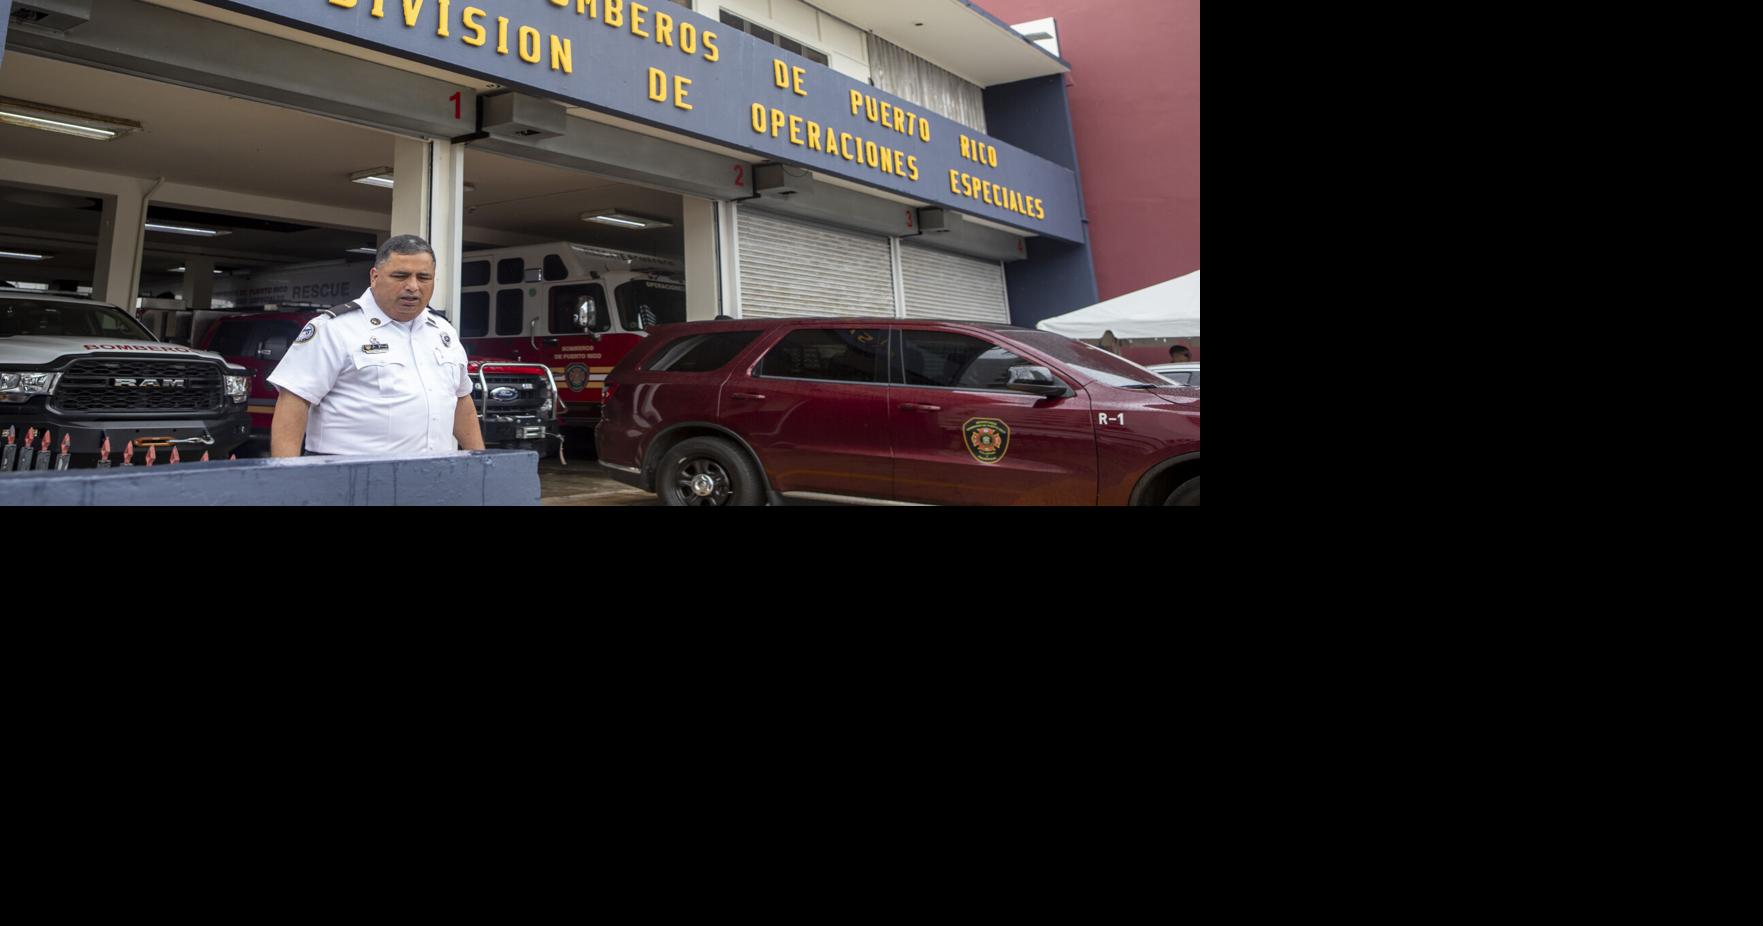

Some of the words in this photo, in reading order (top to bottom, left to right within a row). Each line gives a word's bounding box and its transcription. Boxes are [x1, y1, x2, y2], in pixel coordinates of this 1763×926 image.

[548, 0, 720, 62] BEROS
[773, 59, 808, 97] DE
[849, 89, 931, 143] PUERTO
[959, 135, 998, 168] RICO
[328, 0, 573, 74] VISION
[648, 67, 693, 111] DE
[751, 103, 919, 182] OPERACIONES
[948, 169, 1045, 220] ESPECIALES
[448, 91, 462, 120] 1
[733, 164, 745, 187] 2
[905, 210, 913, 230] 3
[292, 281, 350, 299] RESCUE
[114, 378, 185, 388] RAM
[1098, 412, 1125, 426] R-1
